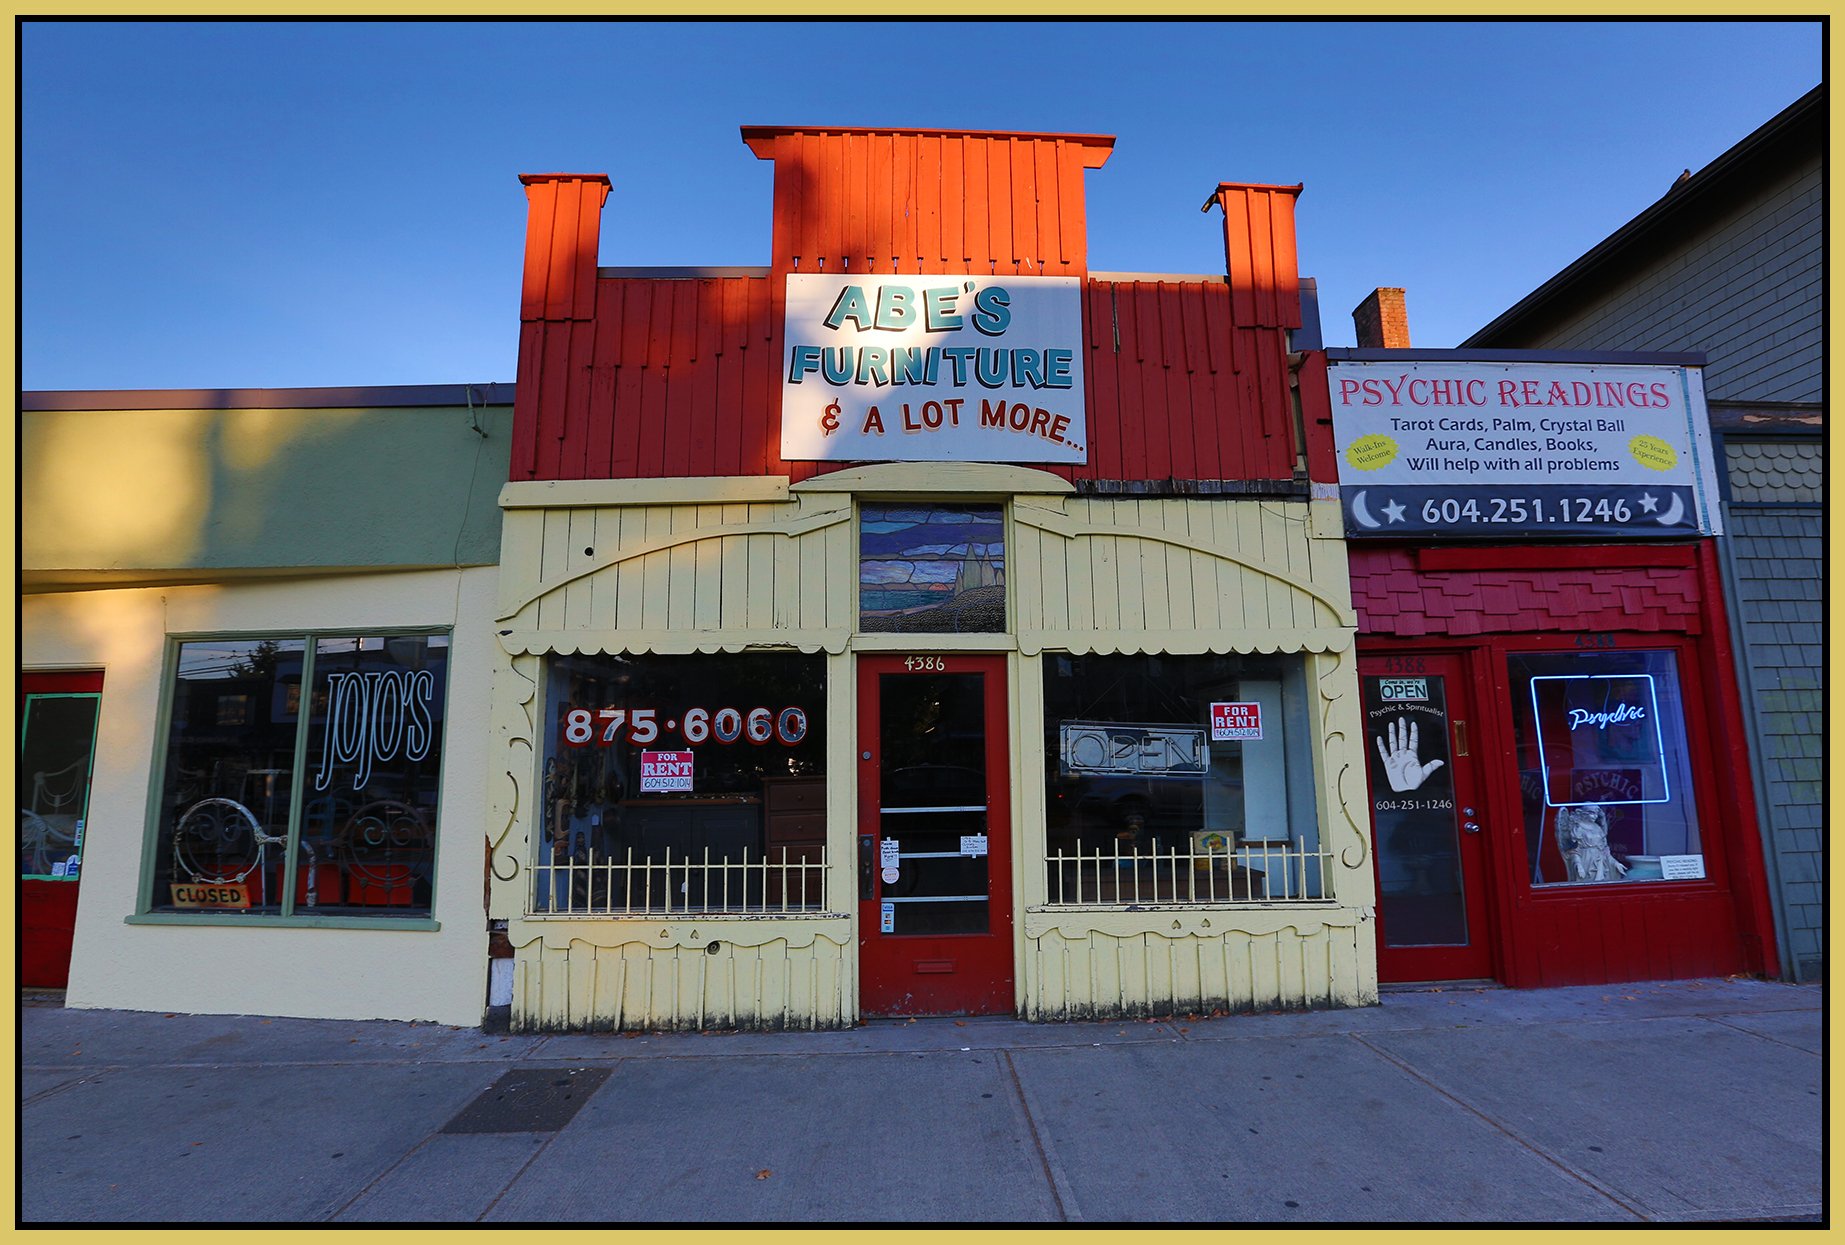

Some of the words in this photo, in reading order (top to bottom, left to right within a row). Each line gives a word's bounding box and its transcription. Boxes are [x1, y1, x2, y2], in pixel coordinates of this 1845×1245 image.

[823, 281, 1011, 337] ABE'S
[788, 345, 1073, 390] FURNITURE
[1339, 374, 1488, 407] PSYCHIC
[1496, 379, 1671, 409] READINGS
[863, 406, 885, 434] A
[903, 398, 964, 431] LOT
[981, 398, 1084, 452] MORE...
[1390, 418, 1434, 431] Tarot
[1439, 418, 1488, 433] Cards,
[1493, 418, 1536, 433] Palm,
[1540, 418, 1592, 435] Crystal
[1597, 419, 1625, 432] Ball
[1353, 441, 1387, 454] Walk-Ins
[1426, 438, 1470, 452] Aura,
[1474, 438, 1542, 452] Candles,
[1546, 438, 1598, 452] Books,
[1650, 443, 1669, 455] Years
[1357, 450, 1391, 464] Welcome
[1633, 447, 1672, 465] Experience
[1406, 457, 1439, 471] Will
[1444, 457, 1480, 474] help
[1484, 457, 1520, 471] with
[1524, 457, 1543, 471] all
[1547, 458, 1620, 474] problems
[1421, 498, 1632, 524] 604.251.1246
[904, 656, 945, 672] 4386
[1381, 684, 1427, 699] OPEN
[1223, 706, 1249, 716] FOR
[1369, 704, 1397, 718] Psychic
[1398, 703, 1405, 711] &
[1405, 702, 1444, 718] Spiritualist
[1568, 703, 1645, 730] Psychic
[1215, 716, 1257, 727] RENT
[315, 670, 434, 791] JOJO'S
[657, 753, 678, 761] FOR
[1072, 733, 1202, 771] OPEN
[643, 762, 692, 776] RENT
[645, 778, 661, 788] 604
[1575, 771, 1640, 799] PSYCHIC
[1376, 799, 1453, 811] 604-251-1246
[176, 887, 241, 903] CLOSED
